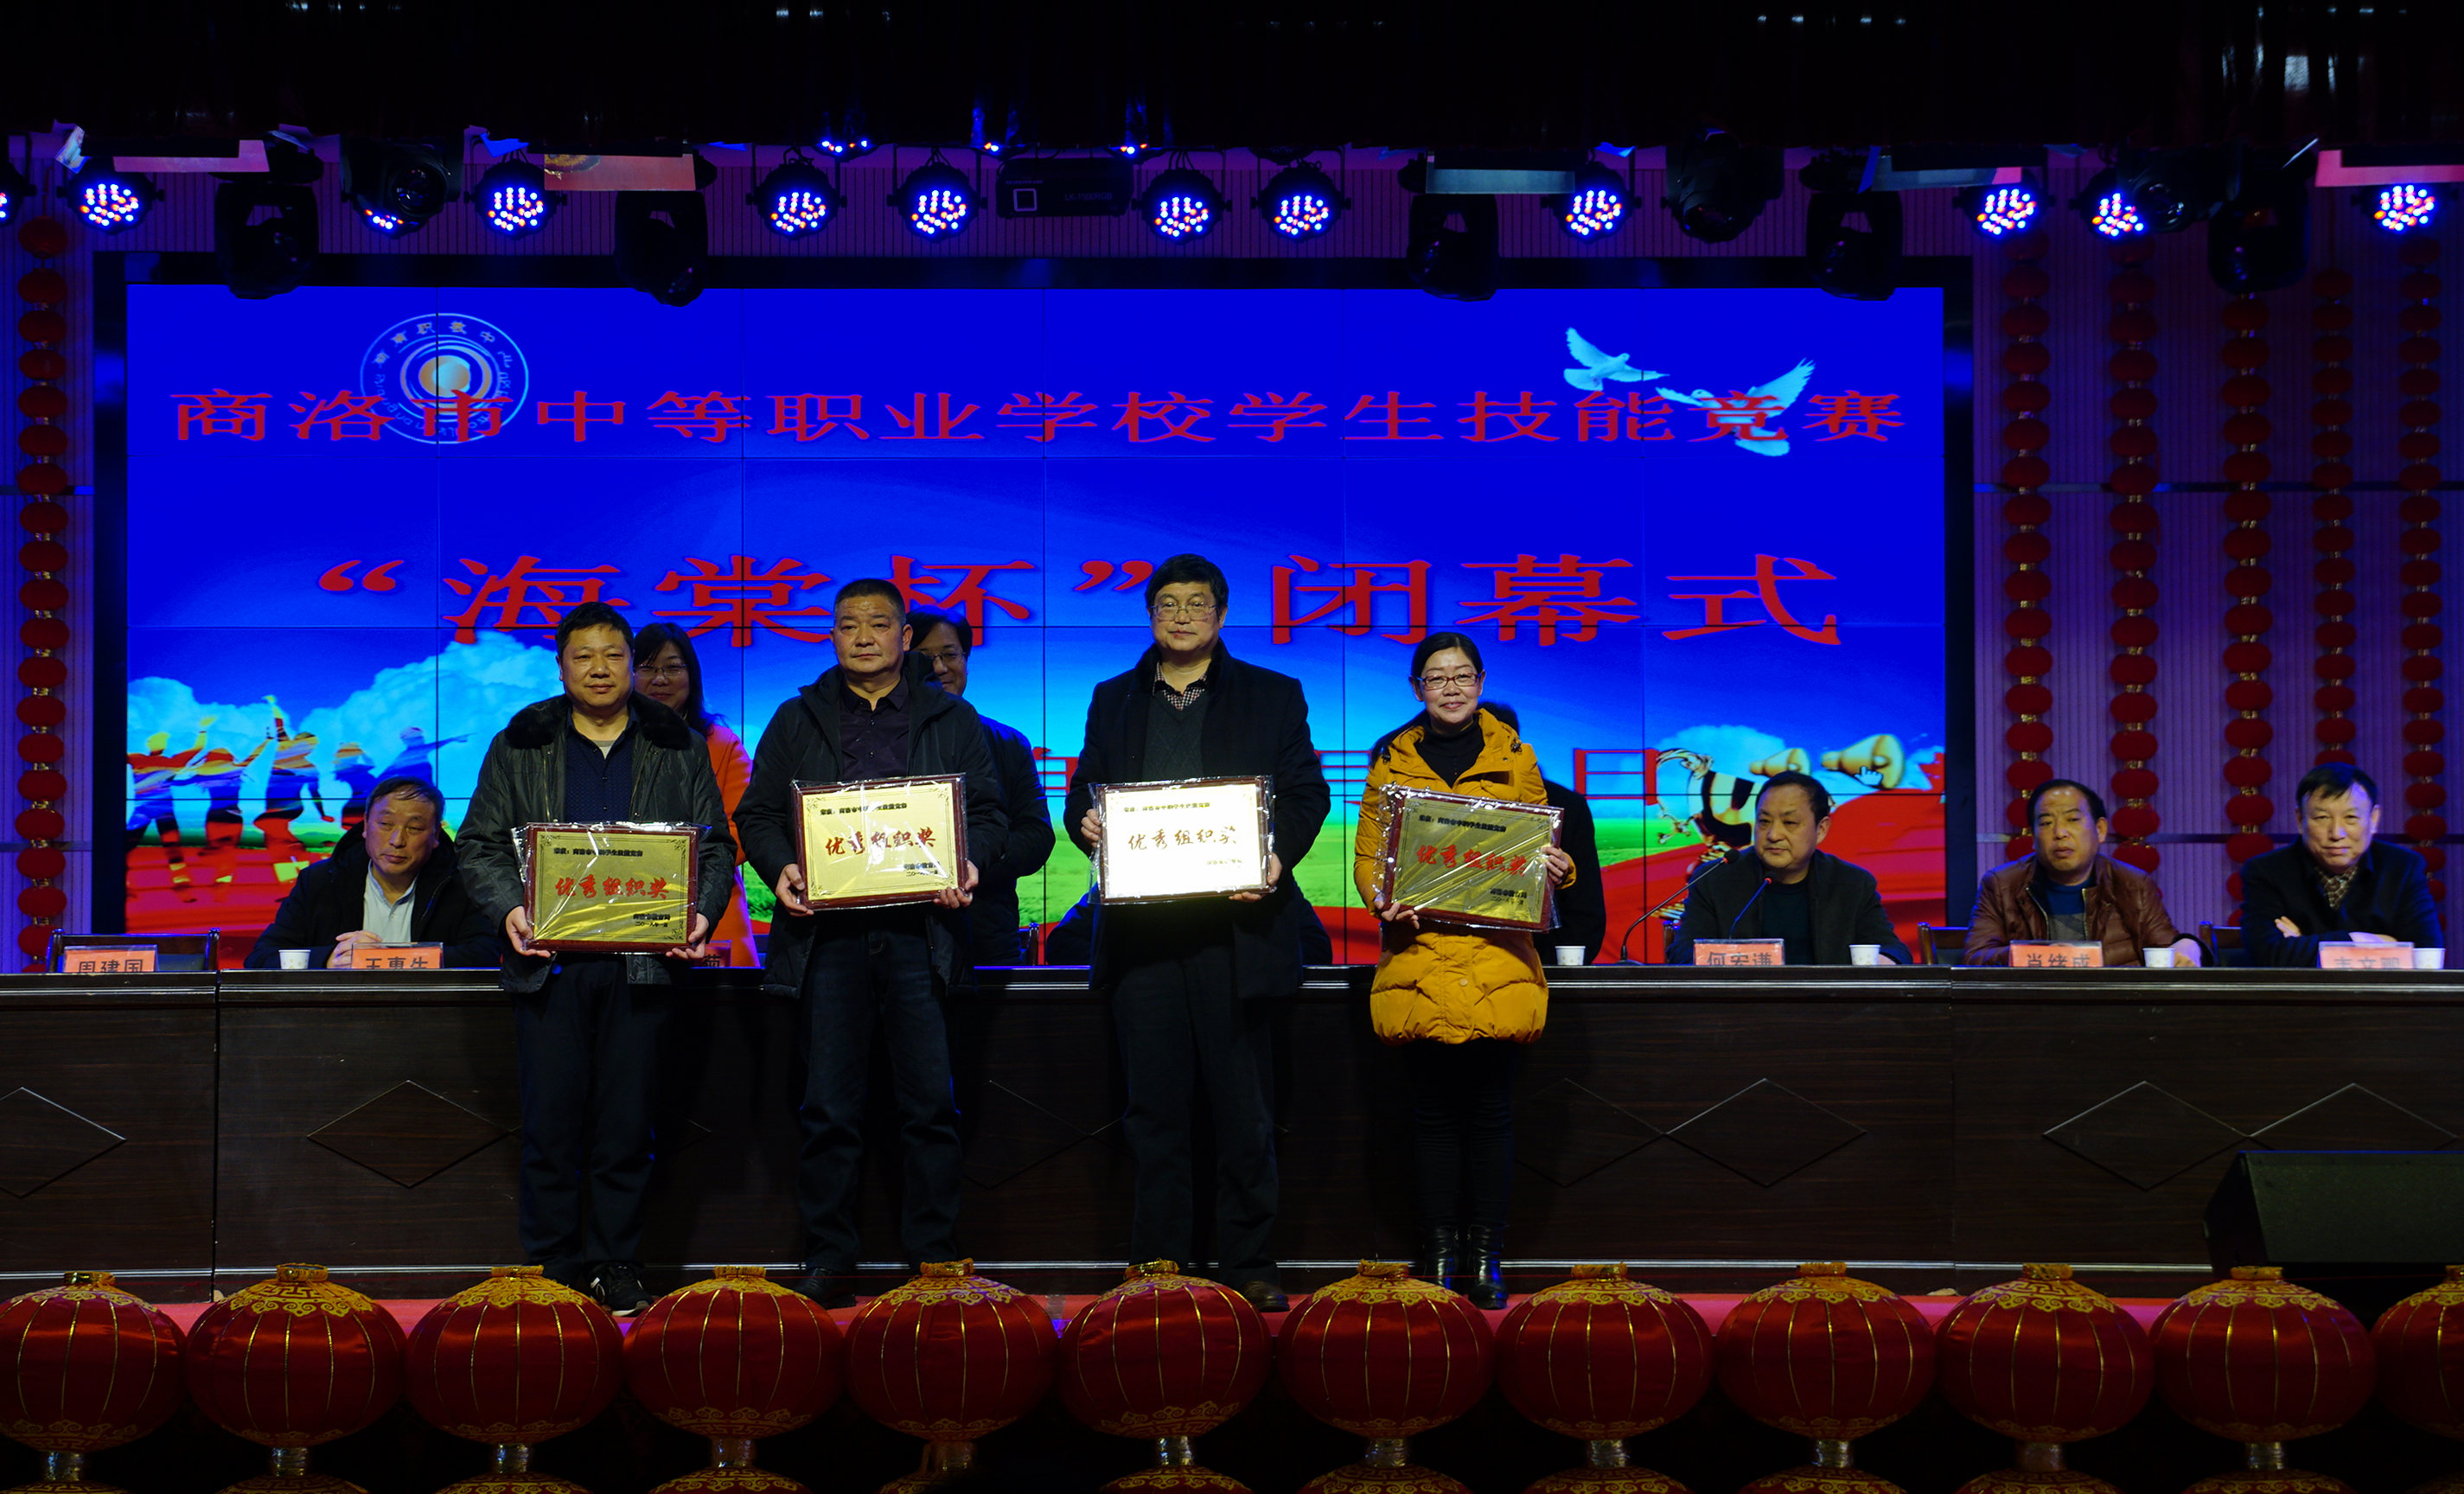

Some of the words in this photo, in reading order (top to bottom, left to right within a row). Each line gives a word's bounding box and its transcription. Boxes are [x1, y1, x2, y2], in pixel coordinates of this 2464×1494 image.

[170, 388, 1906, 444] 商洛市中等职业学校学生技能竞赛
[1415, 844, 1529, 878] 优秀组织奖
[554, 873, 670, 900] 优秀组织奖
